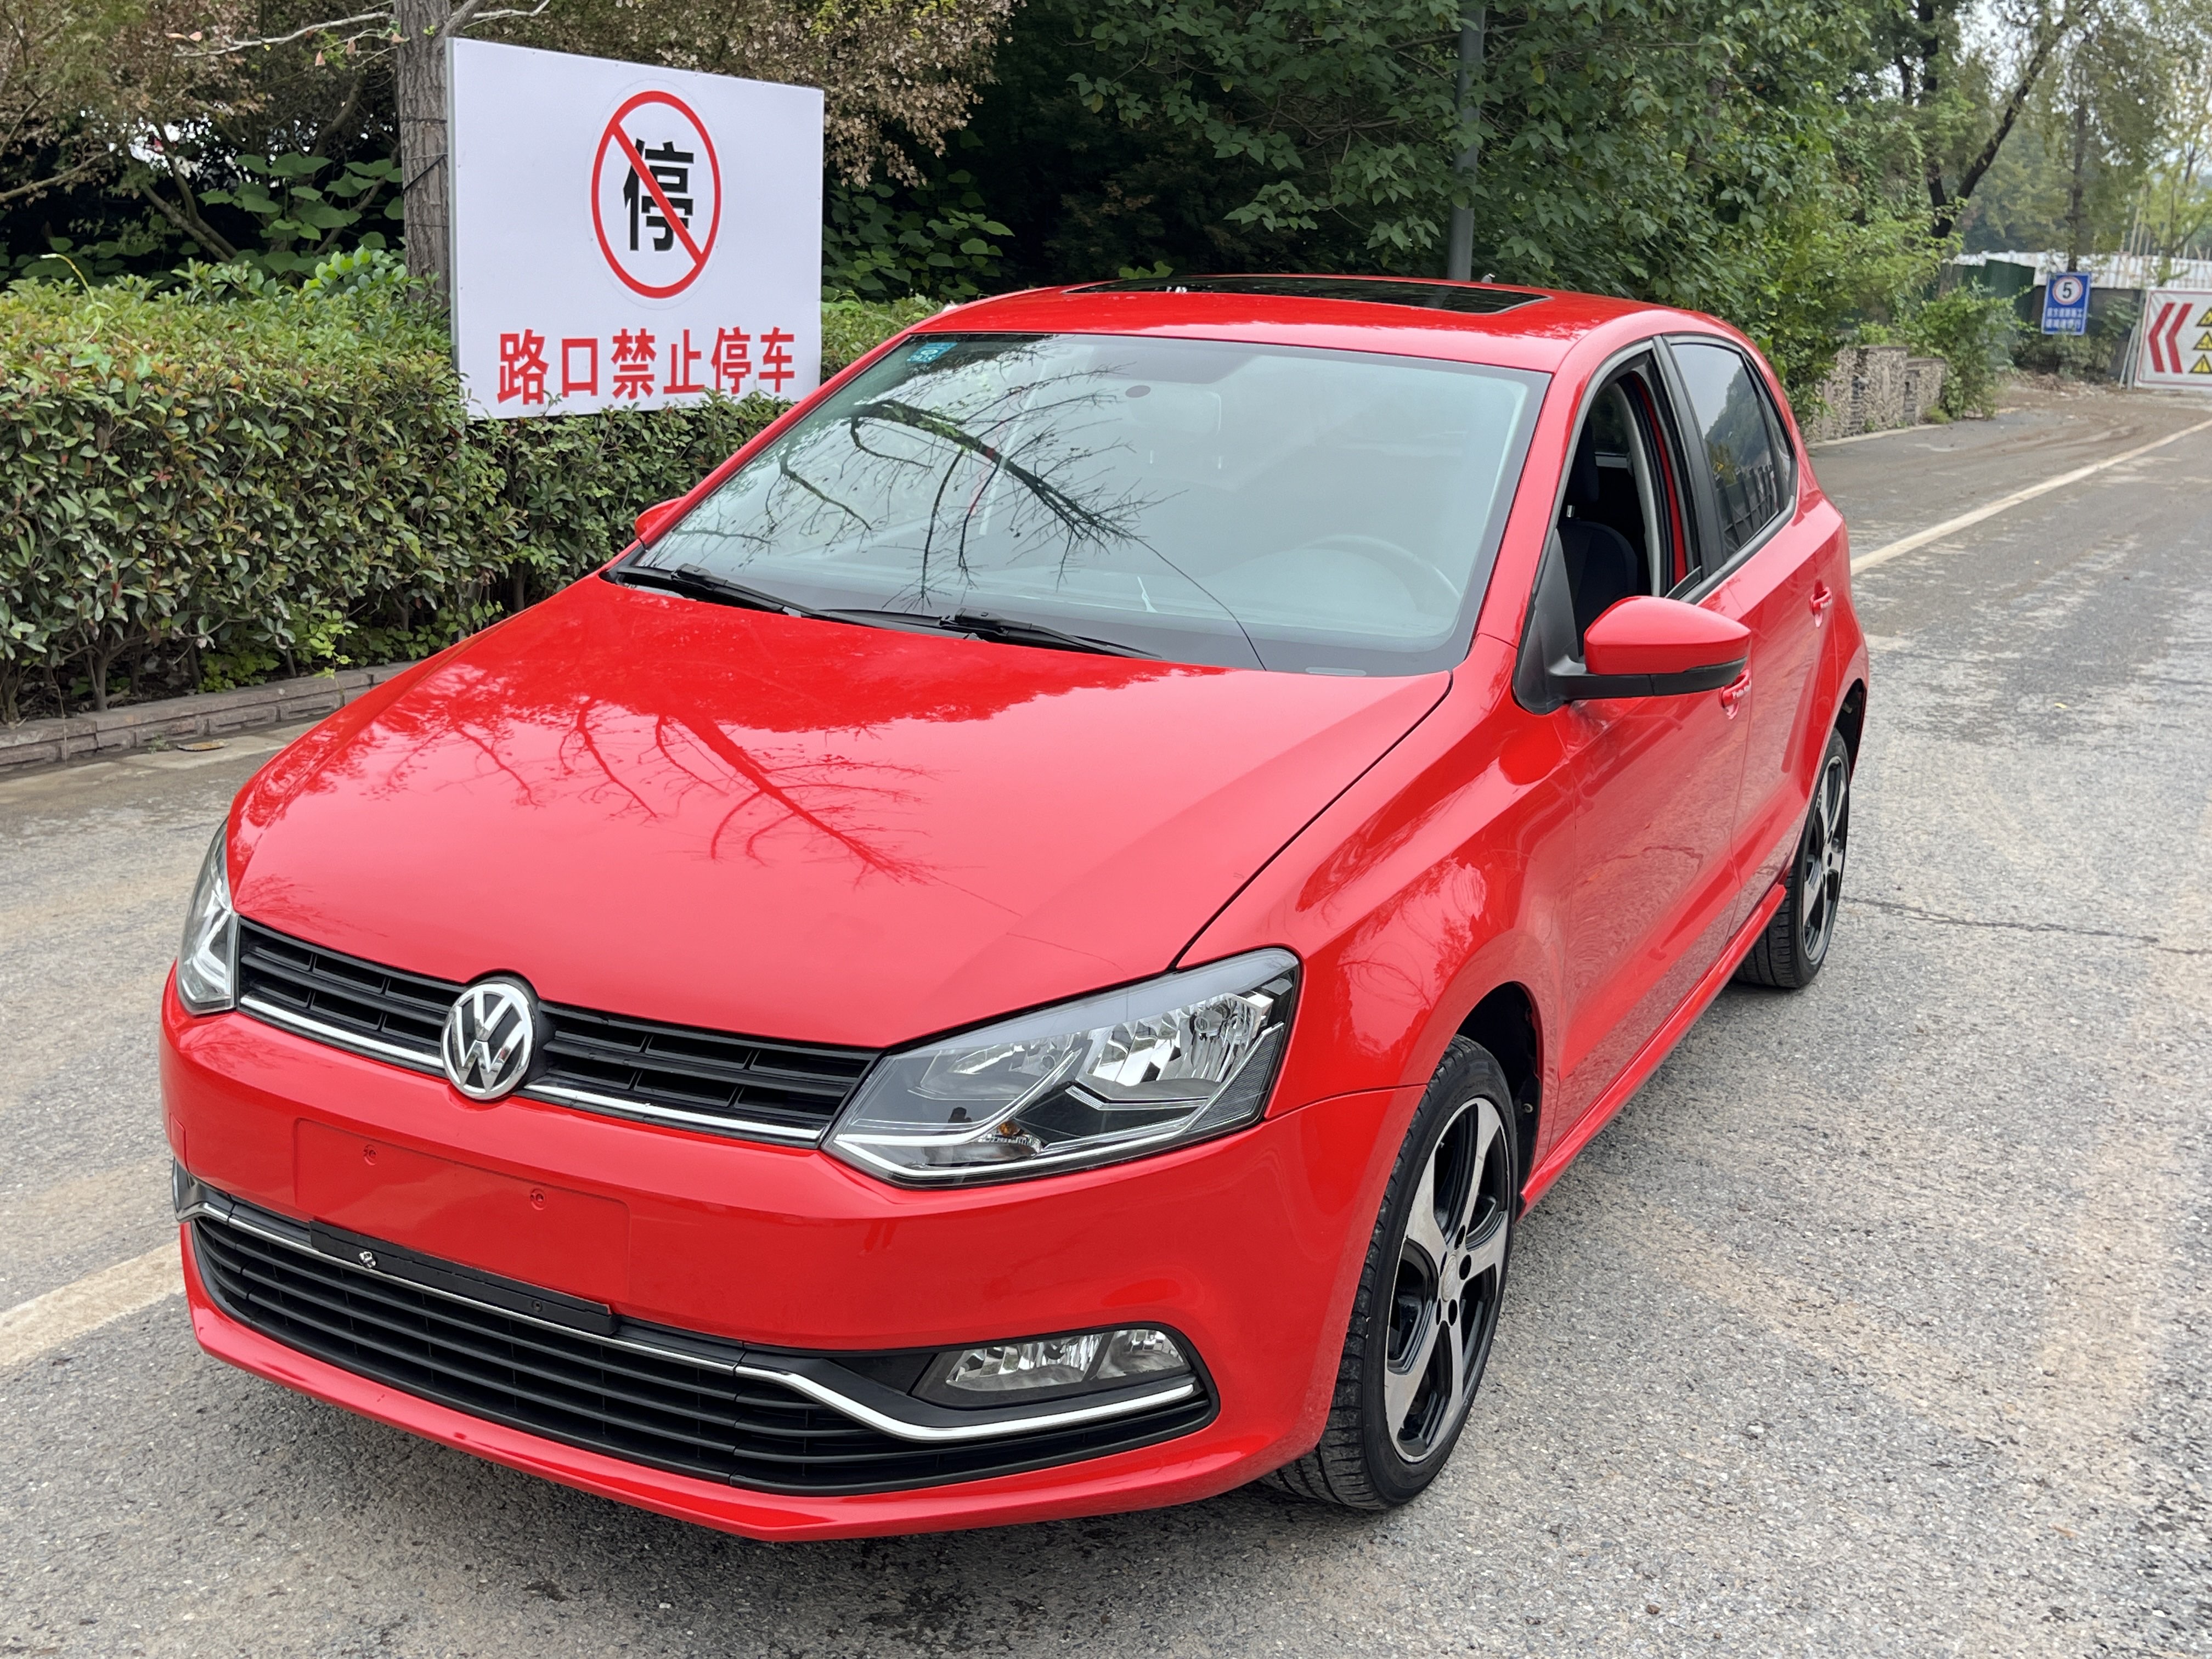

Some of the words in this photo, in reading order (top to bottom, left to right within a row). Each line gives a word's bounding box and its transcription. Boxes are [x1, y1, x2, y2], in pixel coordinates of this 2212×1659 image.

[623, 138, 694, 251] 停
[2062, 281, 2072, 299] 5
[497, 327, 795, 406] 路口禁止停车
